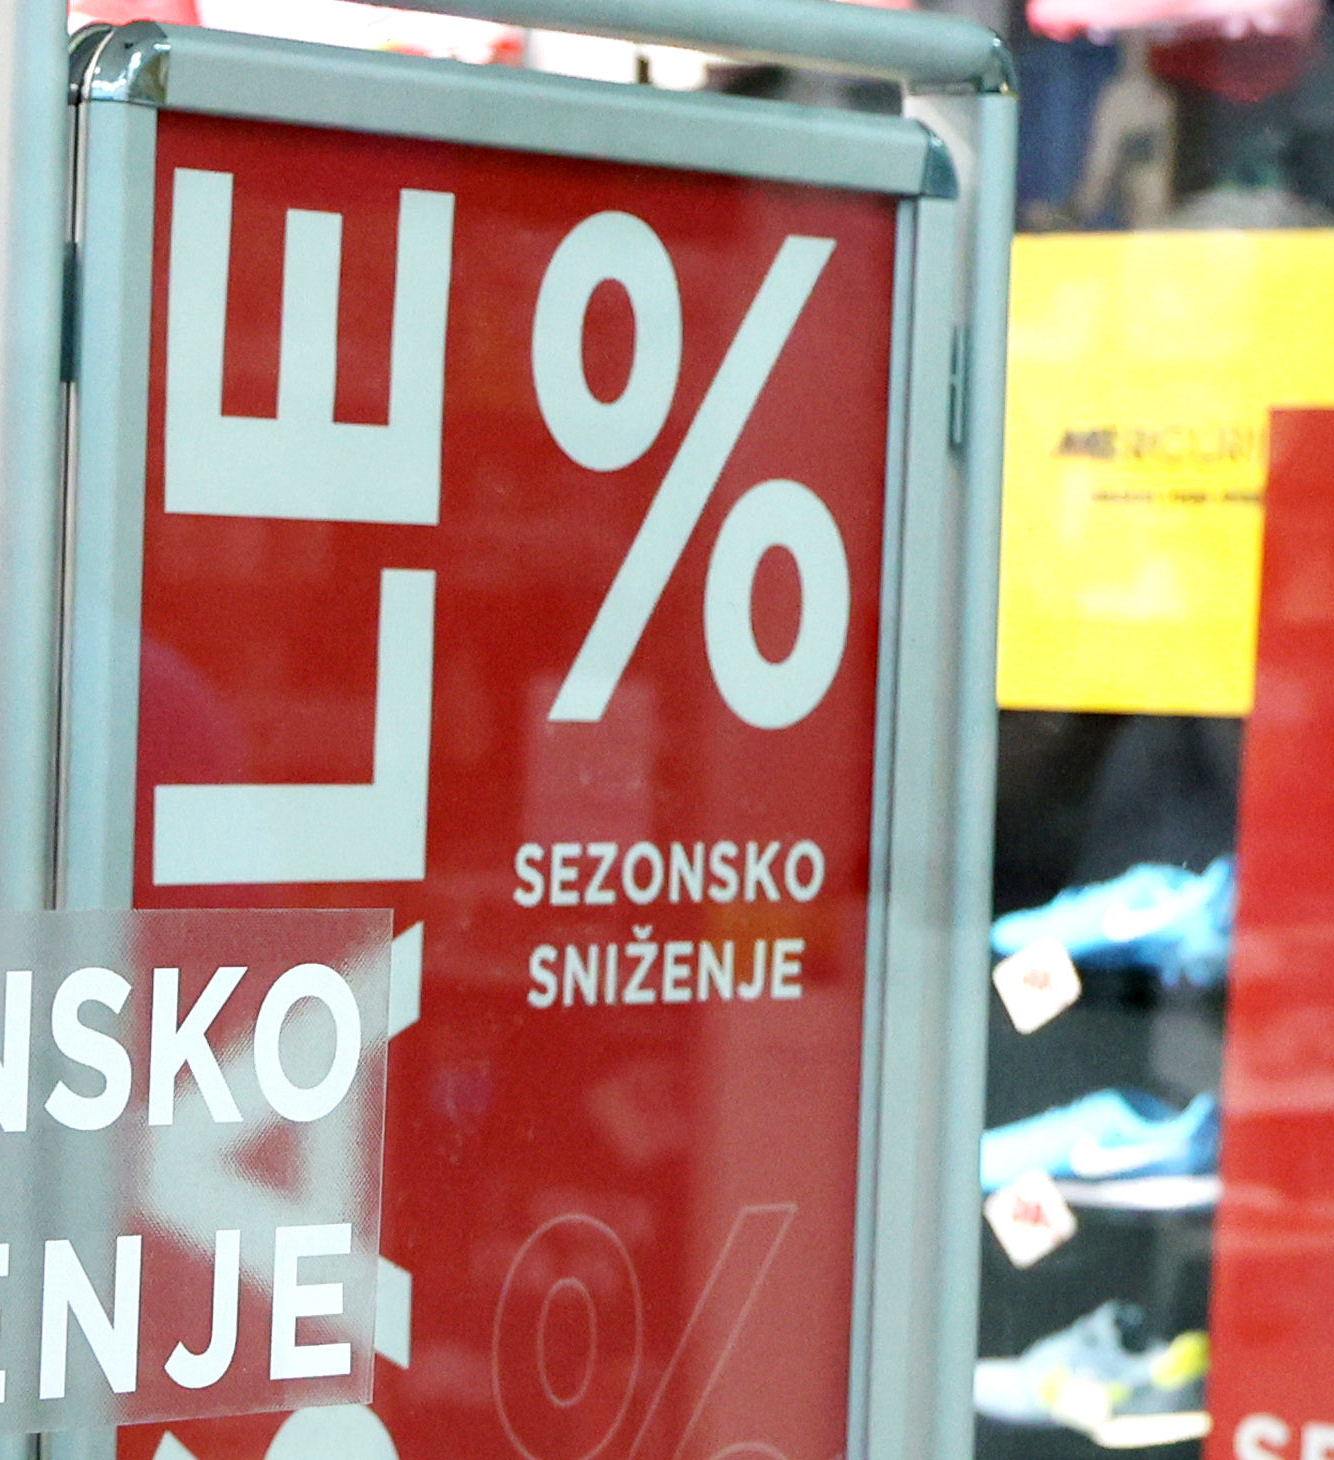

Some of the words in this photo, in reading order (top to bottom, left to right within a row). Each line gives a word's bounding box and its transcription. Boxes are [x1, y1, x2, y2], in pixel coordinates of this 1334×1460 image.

[531, 210, 850, 728] %
[514, 841, 825, 907] SEZONSKO
[528, 926, 804, 1007] SNIŽENJE
